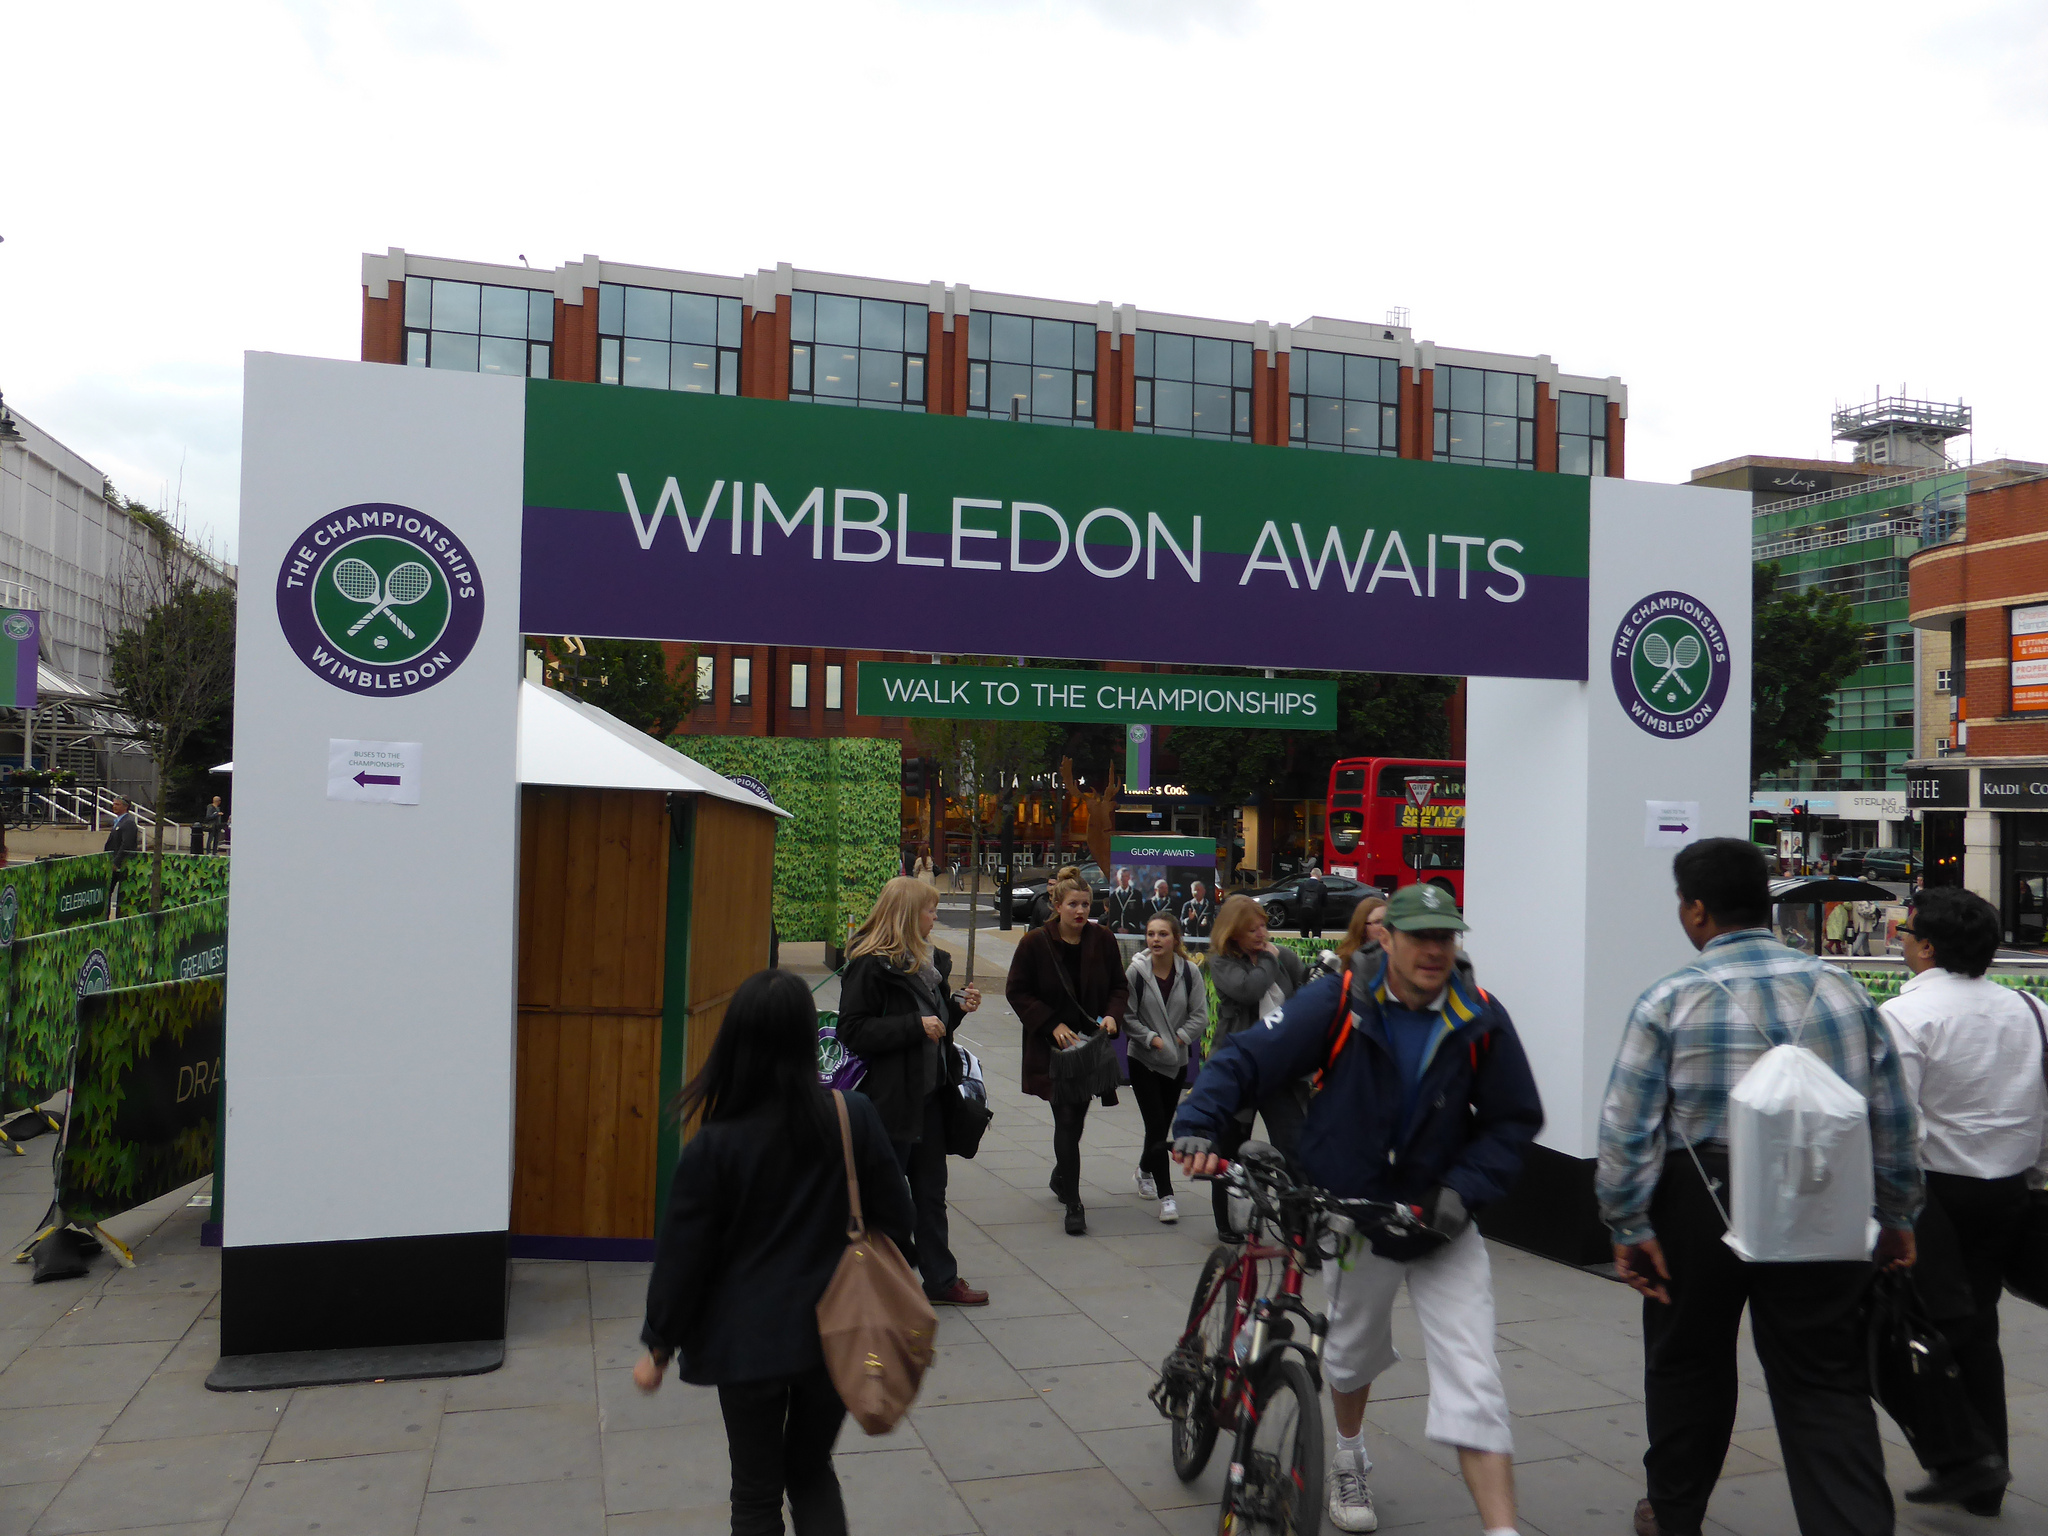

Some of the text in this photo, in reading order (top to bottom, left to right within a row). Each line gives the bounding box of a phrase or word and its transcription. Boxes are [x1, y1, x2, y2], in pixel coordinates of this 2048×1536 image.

[616, 472, 1527, 604] WIMBLEDON AWAITS
[286, 511, 476, 599] THE CHAMPIONSHIPS
[1616, 597, 1726, 663] THE CHAMPIONSHIPS
[311, 645, 452, 689] WIMBLEDON
[882, 677, 1317, 716] WALK TO THE CHAMPIONSHIPS
[1630, 700, 1713, 733] WIMBLEDON
[348, 759, 405, 769] CHAMPIONSHIPS
[354, 750, 376, 758] BUSES
[1853, 797, 1897, 806] STERLING
[1983, 783, 2020, 795] KALDI
[1401, 816, 1457, 828] SEE ME
[1881, 805, 1909, 815] HOUS
[1130, 847, 1195, 858] GLORY AWAITS
[60, 887, 104, 913] CELEBRATION
[180, 944, 225, 979] GREATNESS
